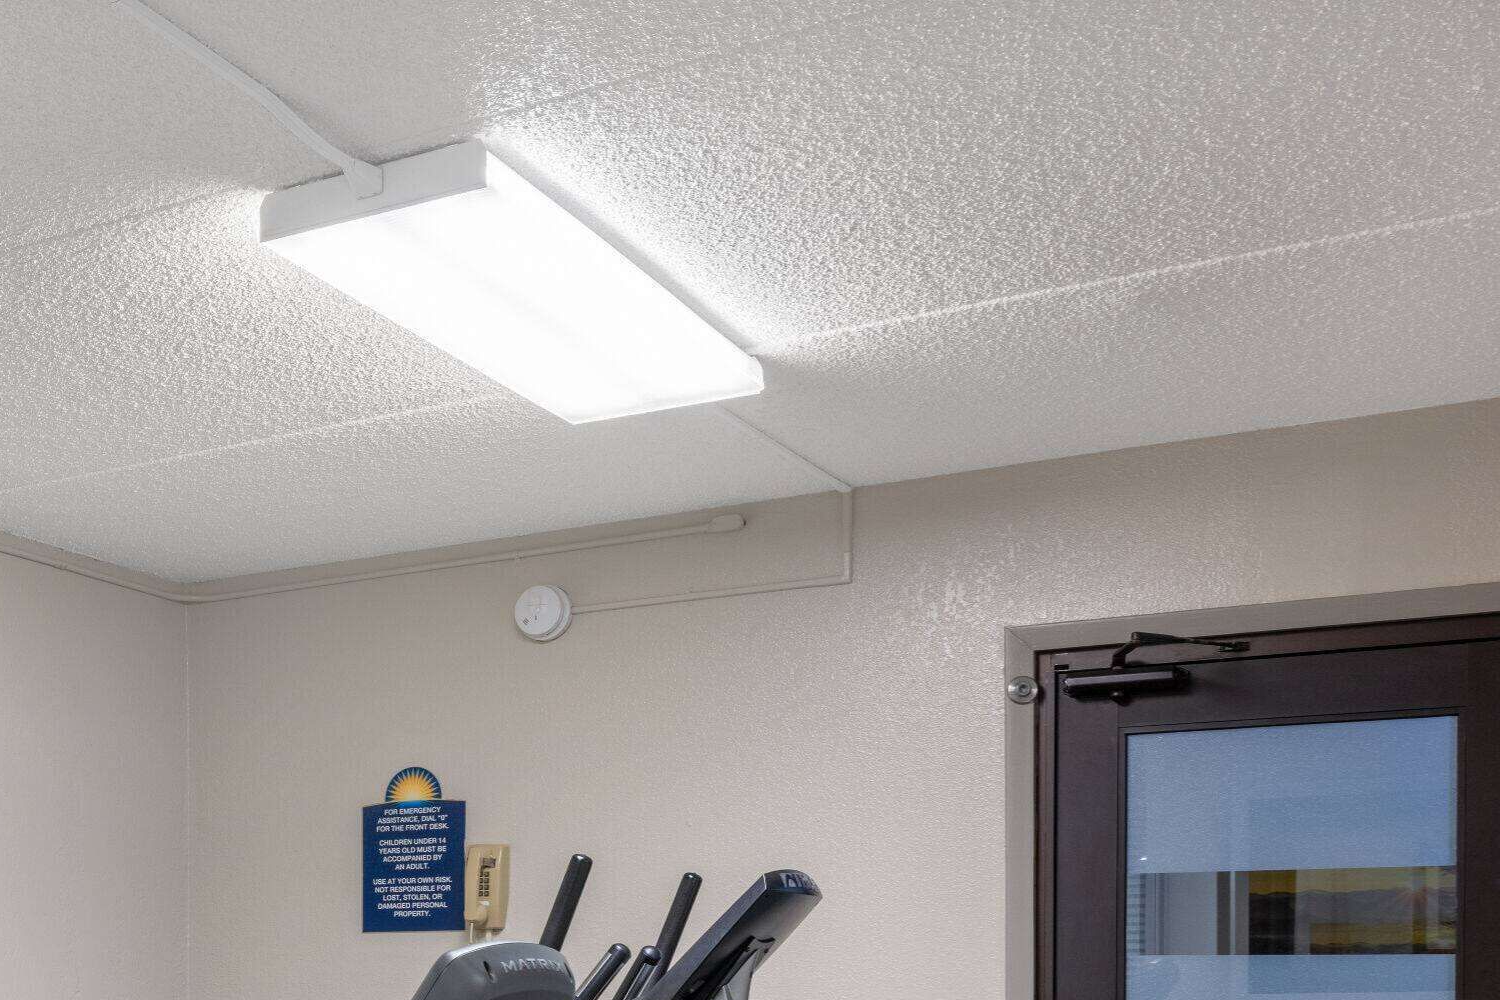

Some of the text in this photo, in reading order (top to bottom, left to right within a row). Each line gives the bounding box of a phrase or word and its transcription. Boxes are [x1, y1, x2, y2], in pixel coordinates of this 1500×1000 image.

[384, 806, 442, 816] FOR EMERGENCY
[377, 815, 420, 825] ASSISTANCE,
[376, 825, 391, 833] FOR
[405, 823, 428, 831] FRONT
[429, 822, 450, 830] DESK.
[379, 838, 413, 847] CHILDREN
[413, 837, 437, 845] UNDER
[378, 847, 401, 855] YEARS
[401, 846, 416, 854] OLD
[382, 854, 432, 863] ACCOMPANIED
[405, 862, 430, 870] ADULT.
[389, 885, 436, 893] RESPONSIBLE
[436, 884, 452, 892] FOR
[402, 893, 431, 901] STOLEN,
[377, 901, 448, 910] DAMAGED PERSONAL
[393, 910, 431, 918] PROPERTY.
